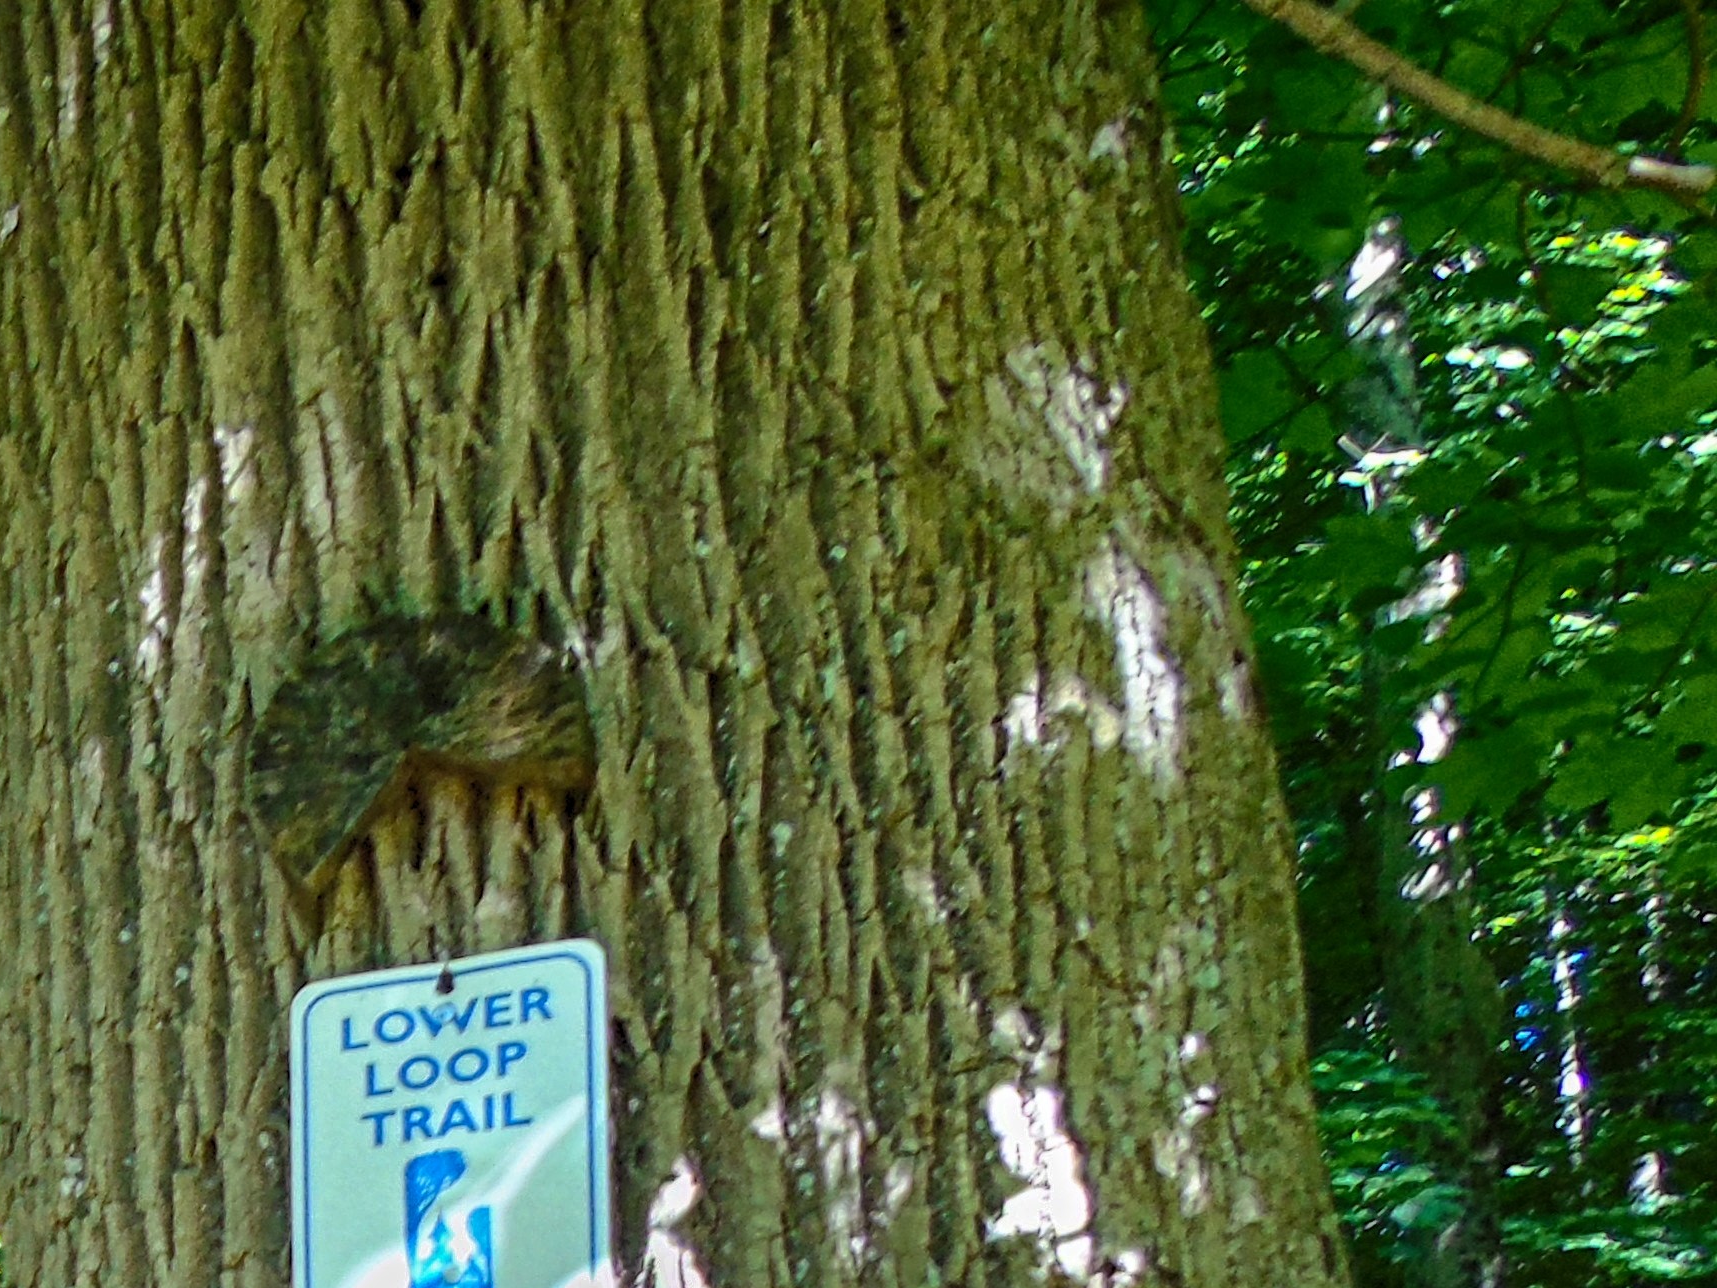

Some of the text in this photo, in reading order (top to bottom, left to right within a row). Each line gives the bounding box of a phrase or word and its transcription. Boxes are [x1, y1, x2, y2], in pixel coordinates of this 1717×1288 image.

[341, 987, 553, 1050] LOWER
[366, 1040, 528, 1096] LOOP
[361, 1091, 534, 1146] TRAIL
